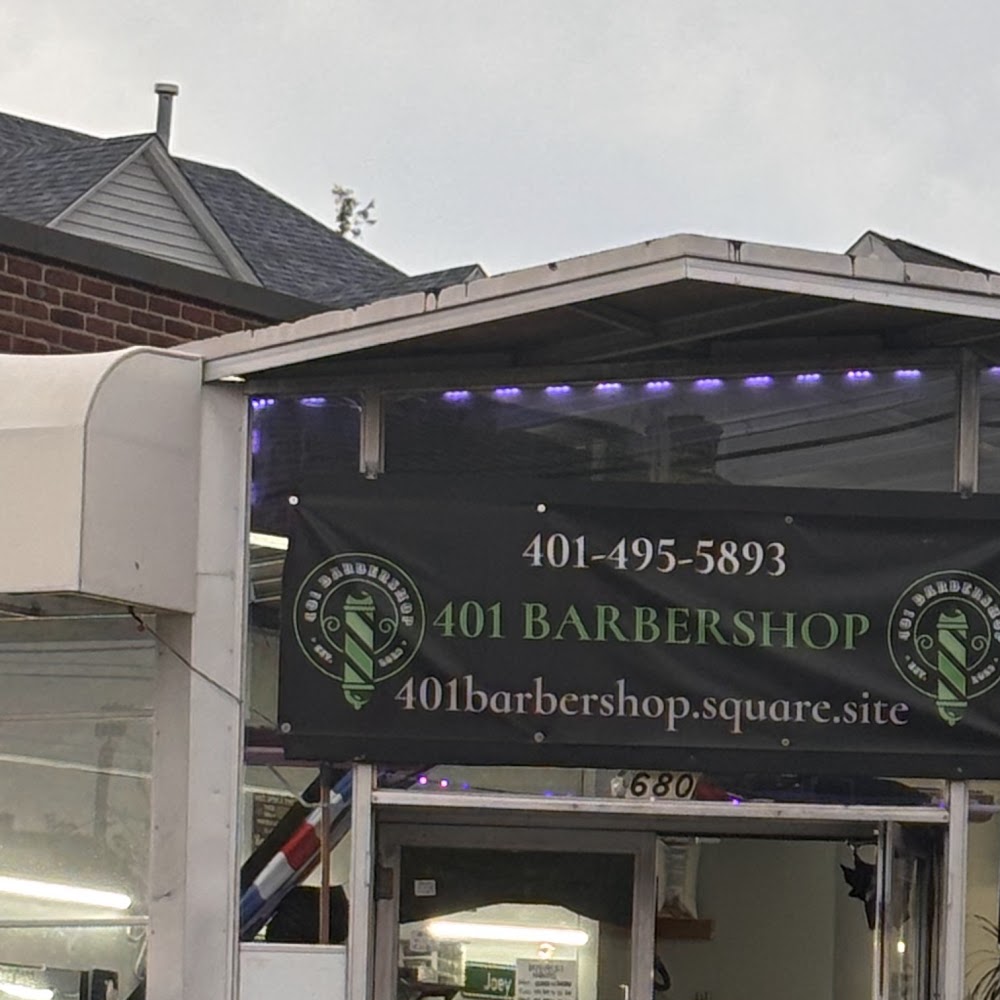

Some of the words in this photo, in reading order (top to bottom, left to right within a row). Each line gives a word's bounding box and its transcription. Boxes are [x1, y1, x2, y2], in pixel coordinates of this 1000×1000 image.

[521, 532, 787, 577] 401-495-5893
[317, 561, 415, 627] BARBERSHOP
[432, 600, 507, 640] 401
[521, 602, 871, 651] BARBERSHOP
[394, 674, 910, 734] 401barbershop.square.site
[630, 771, 694, 799] 680
[483, 971, 513, 998] Joey
